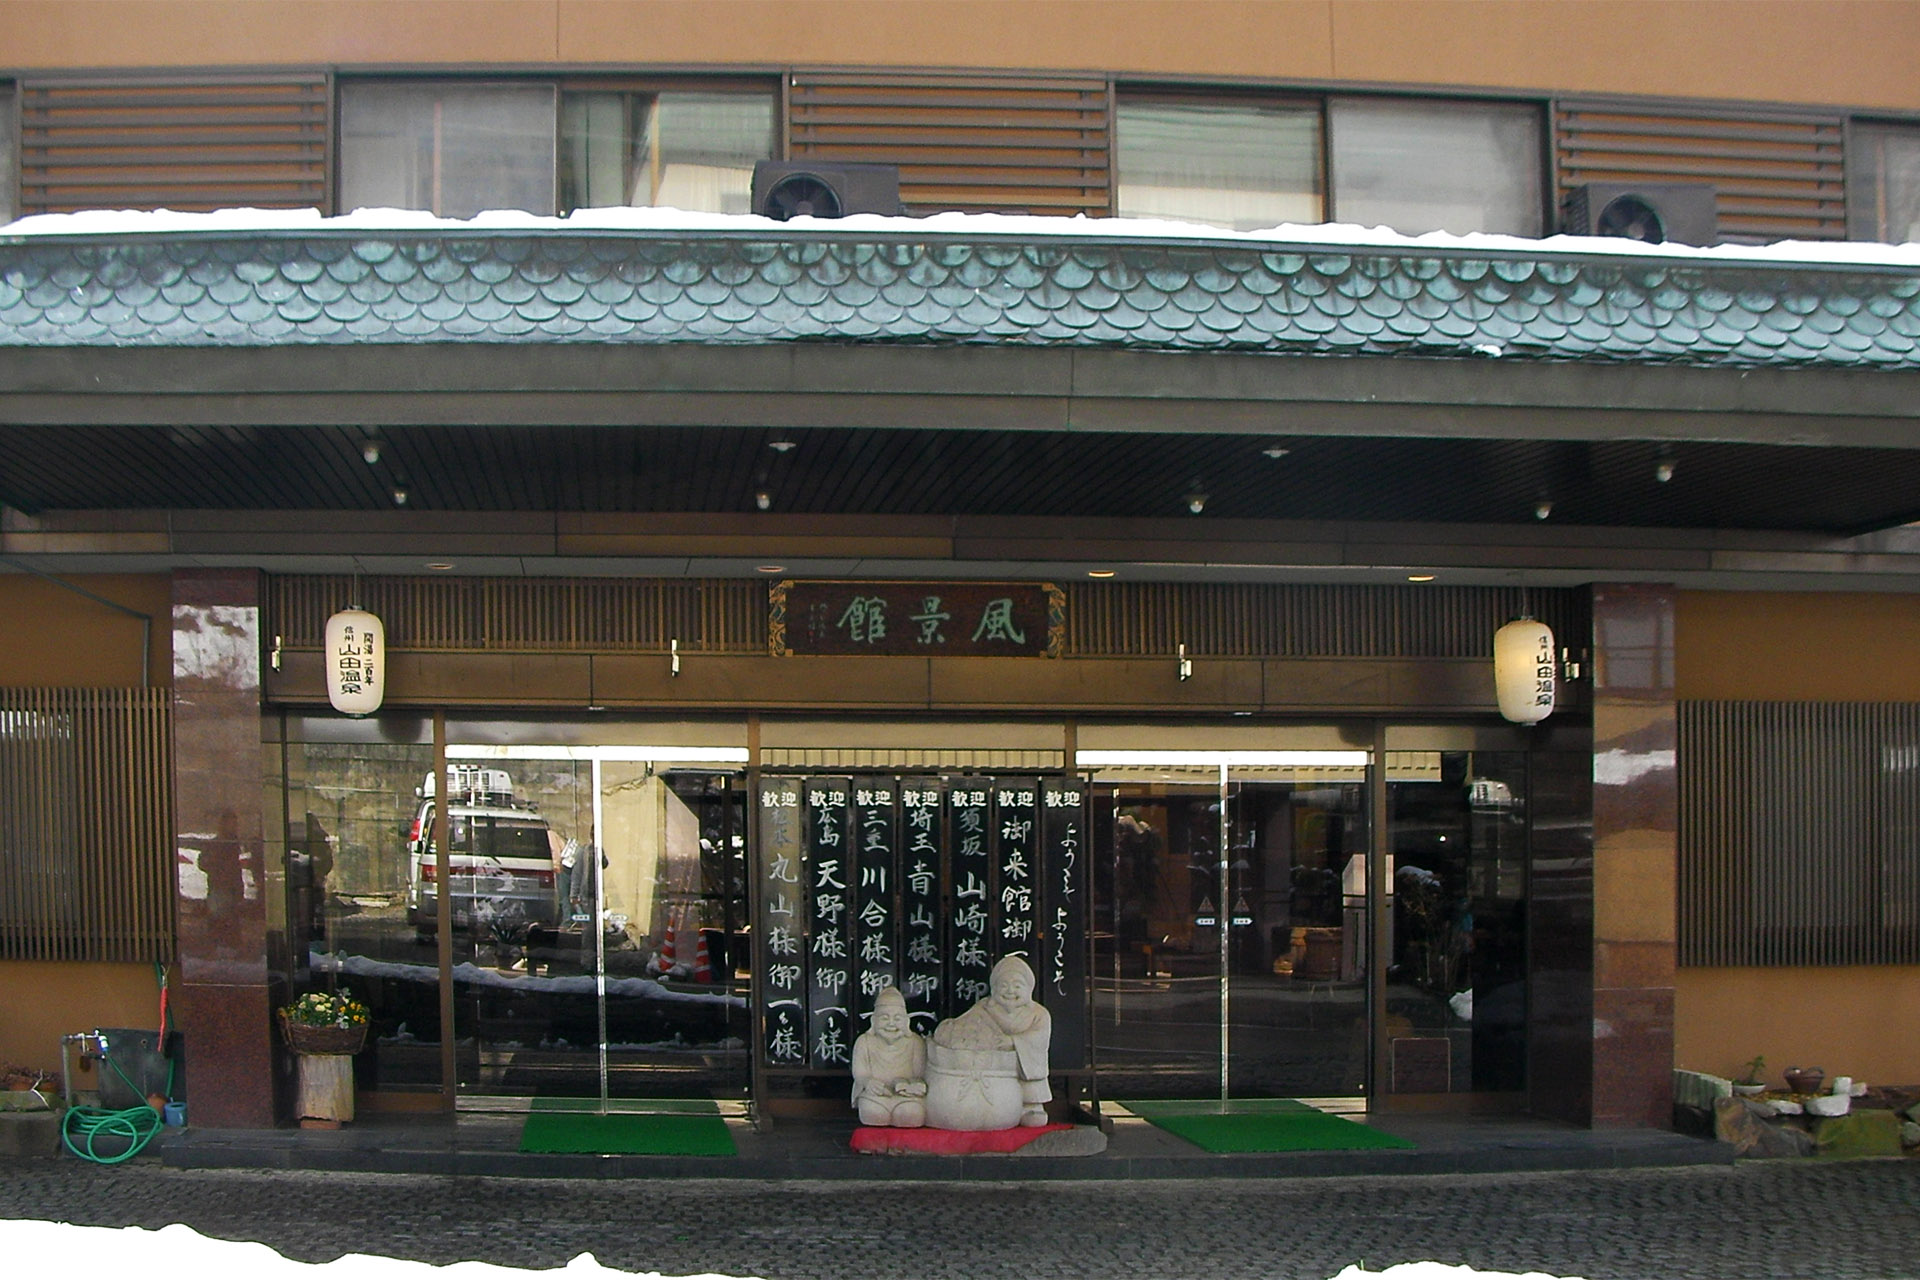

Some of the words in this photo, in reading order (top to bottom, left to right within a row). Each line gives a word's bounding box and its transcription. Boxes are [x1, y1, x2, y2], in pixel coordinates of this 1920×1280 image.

[837, 596, 1026, 644] 風景館
[761, 790, 798, 808] 歓迎
[809, 790, 846, 807] 歓迎
[856, 789, 893, 806] 歓迎
[903, 790, 939, 807] 歓迎
[952, 790, 987, 807] 歓迎
[998, 790, 1034, 807] 歓迎
[1045, 790, 1081, 807] 歓迎
